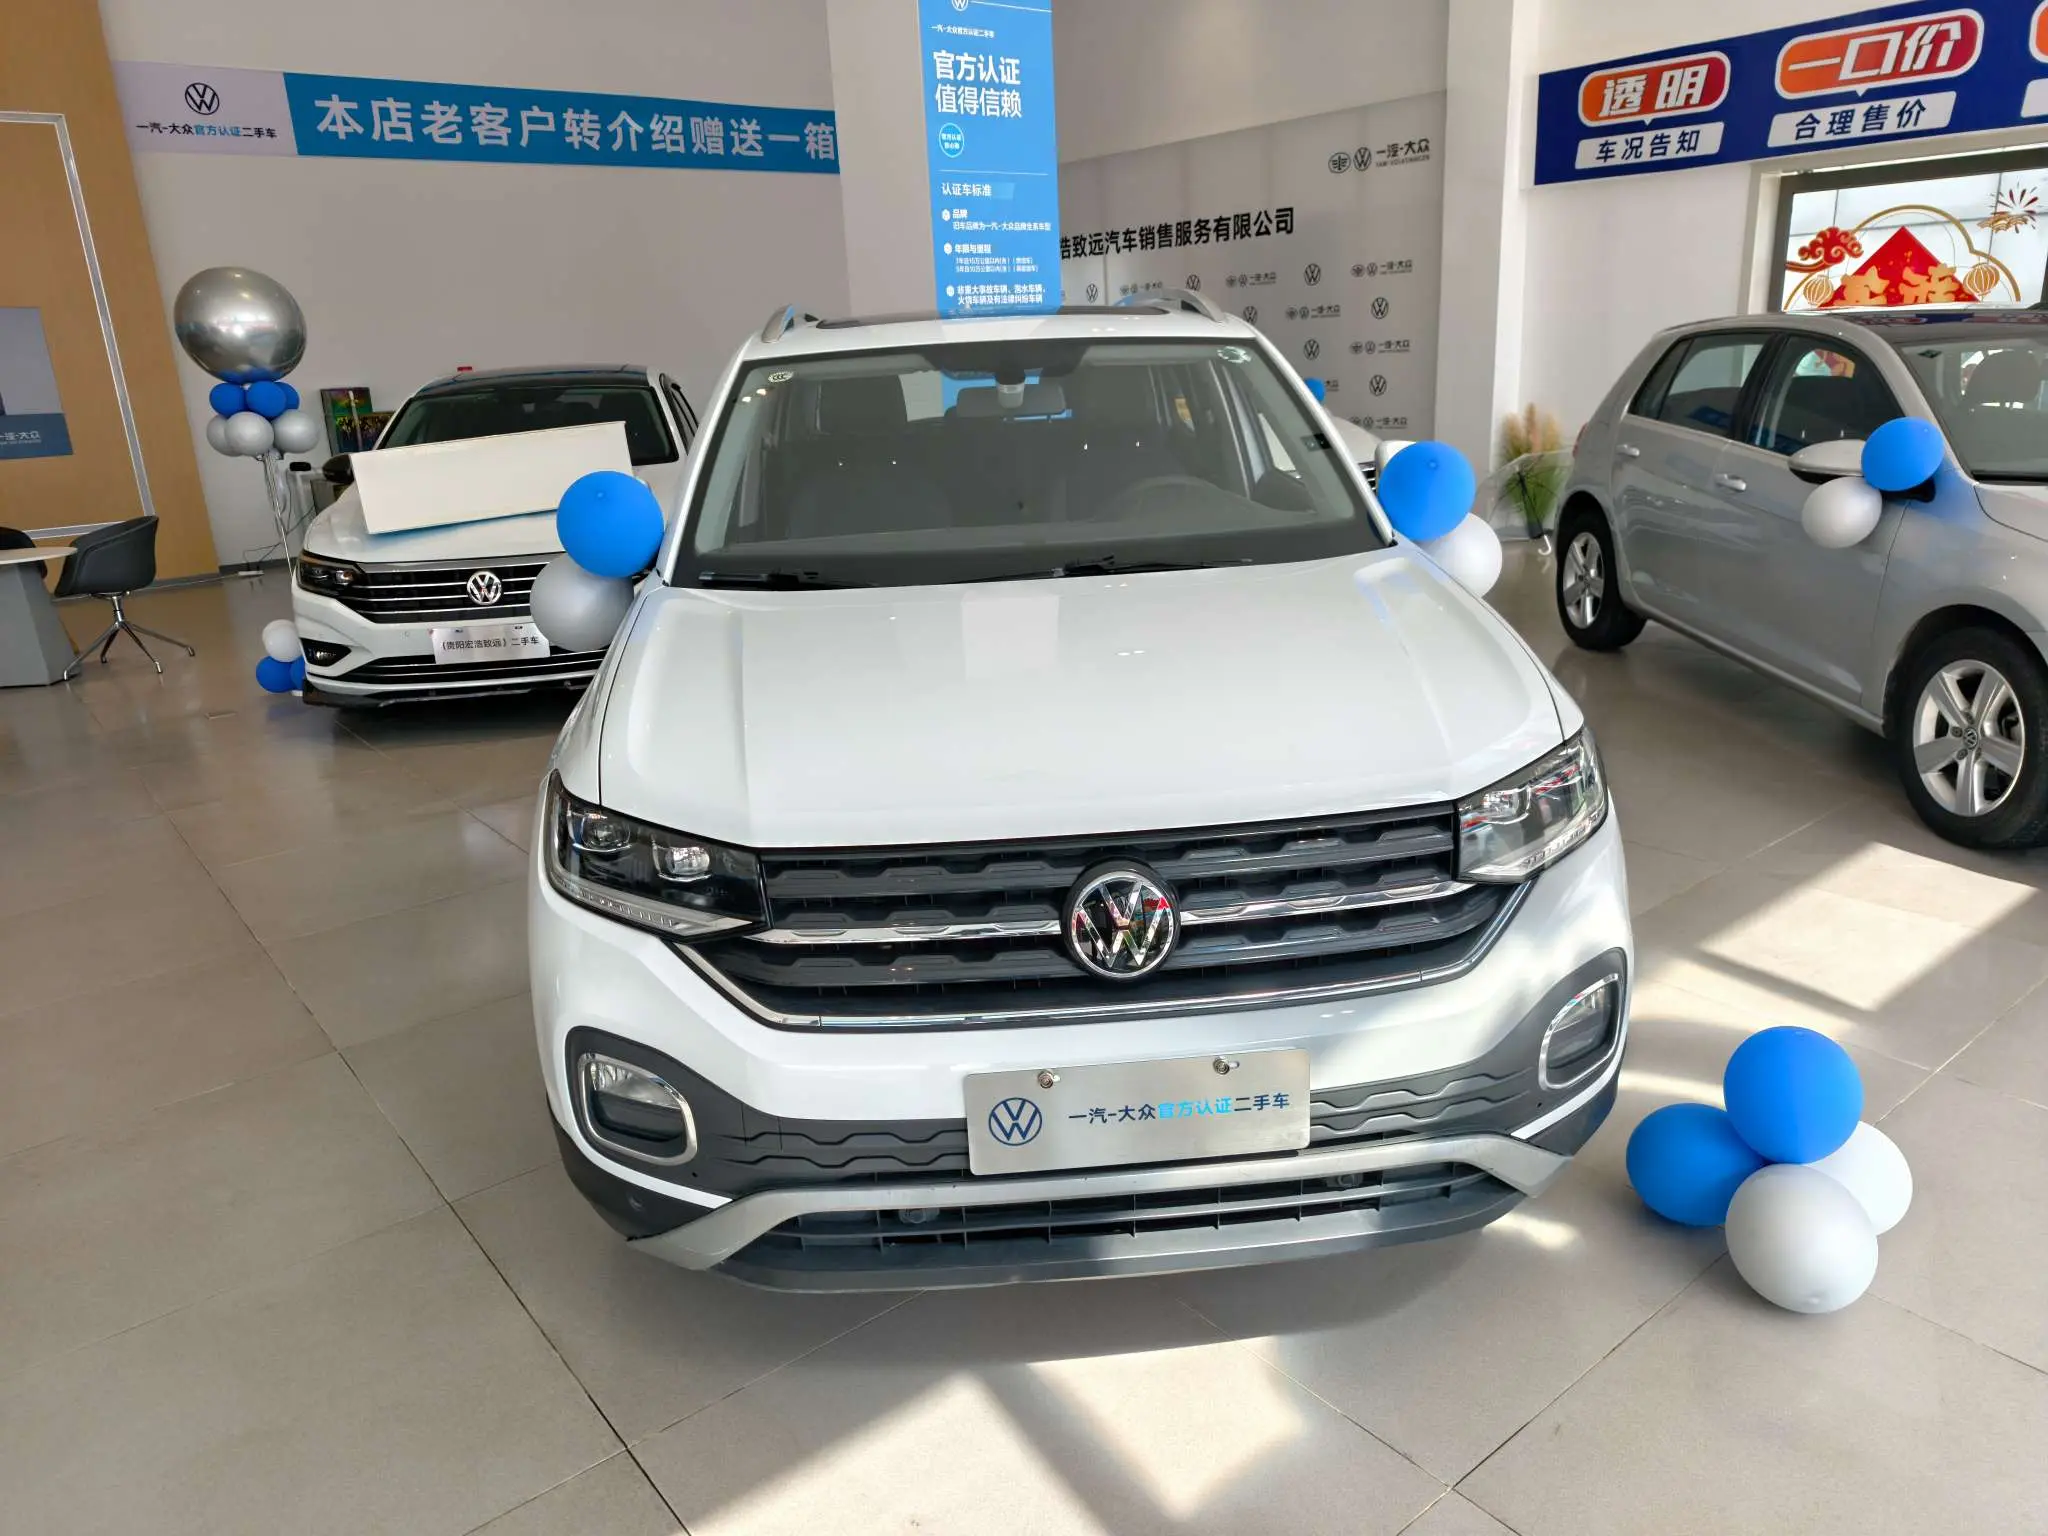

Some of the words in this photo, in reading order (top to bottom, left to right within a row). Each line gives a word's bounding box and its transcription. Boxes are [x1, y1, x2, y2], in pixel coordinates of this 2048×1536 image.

[933, 50, 1021, 85] 官方认证
[1788, 21, 1962, 80] 一口价
[935, 83, 1022, 118] 值得信赖
[1598, 64, 1709, 117] 透明
[136, 122, 278, 138] 一汽-大众官方认证二手车
[314, 94, 836, 159] 本店老客户转介绍赠送一箱
[1794, 99, 1926, 141] 合理售价
[1596, 130, 1701, 162] 车况告知
[942, 183, 992, 197] 认证车标准
[1060, 207, 1294, 259] 浩致远汽车销售服务有限公司
[1068, 1092, 1290, 1124] 一汽-大众官方认证二手车
